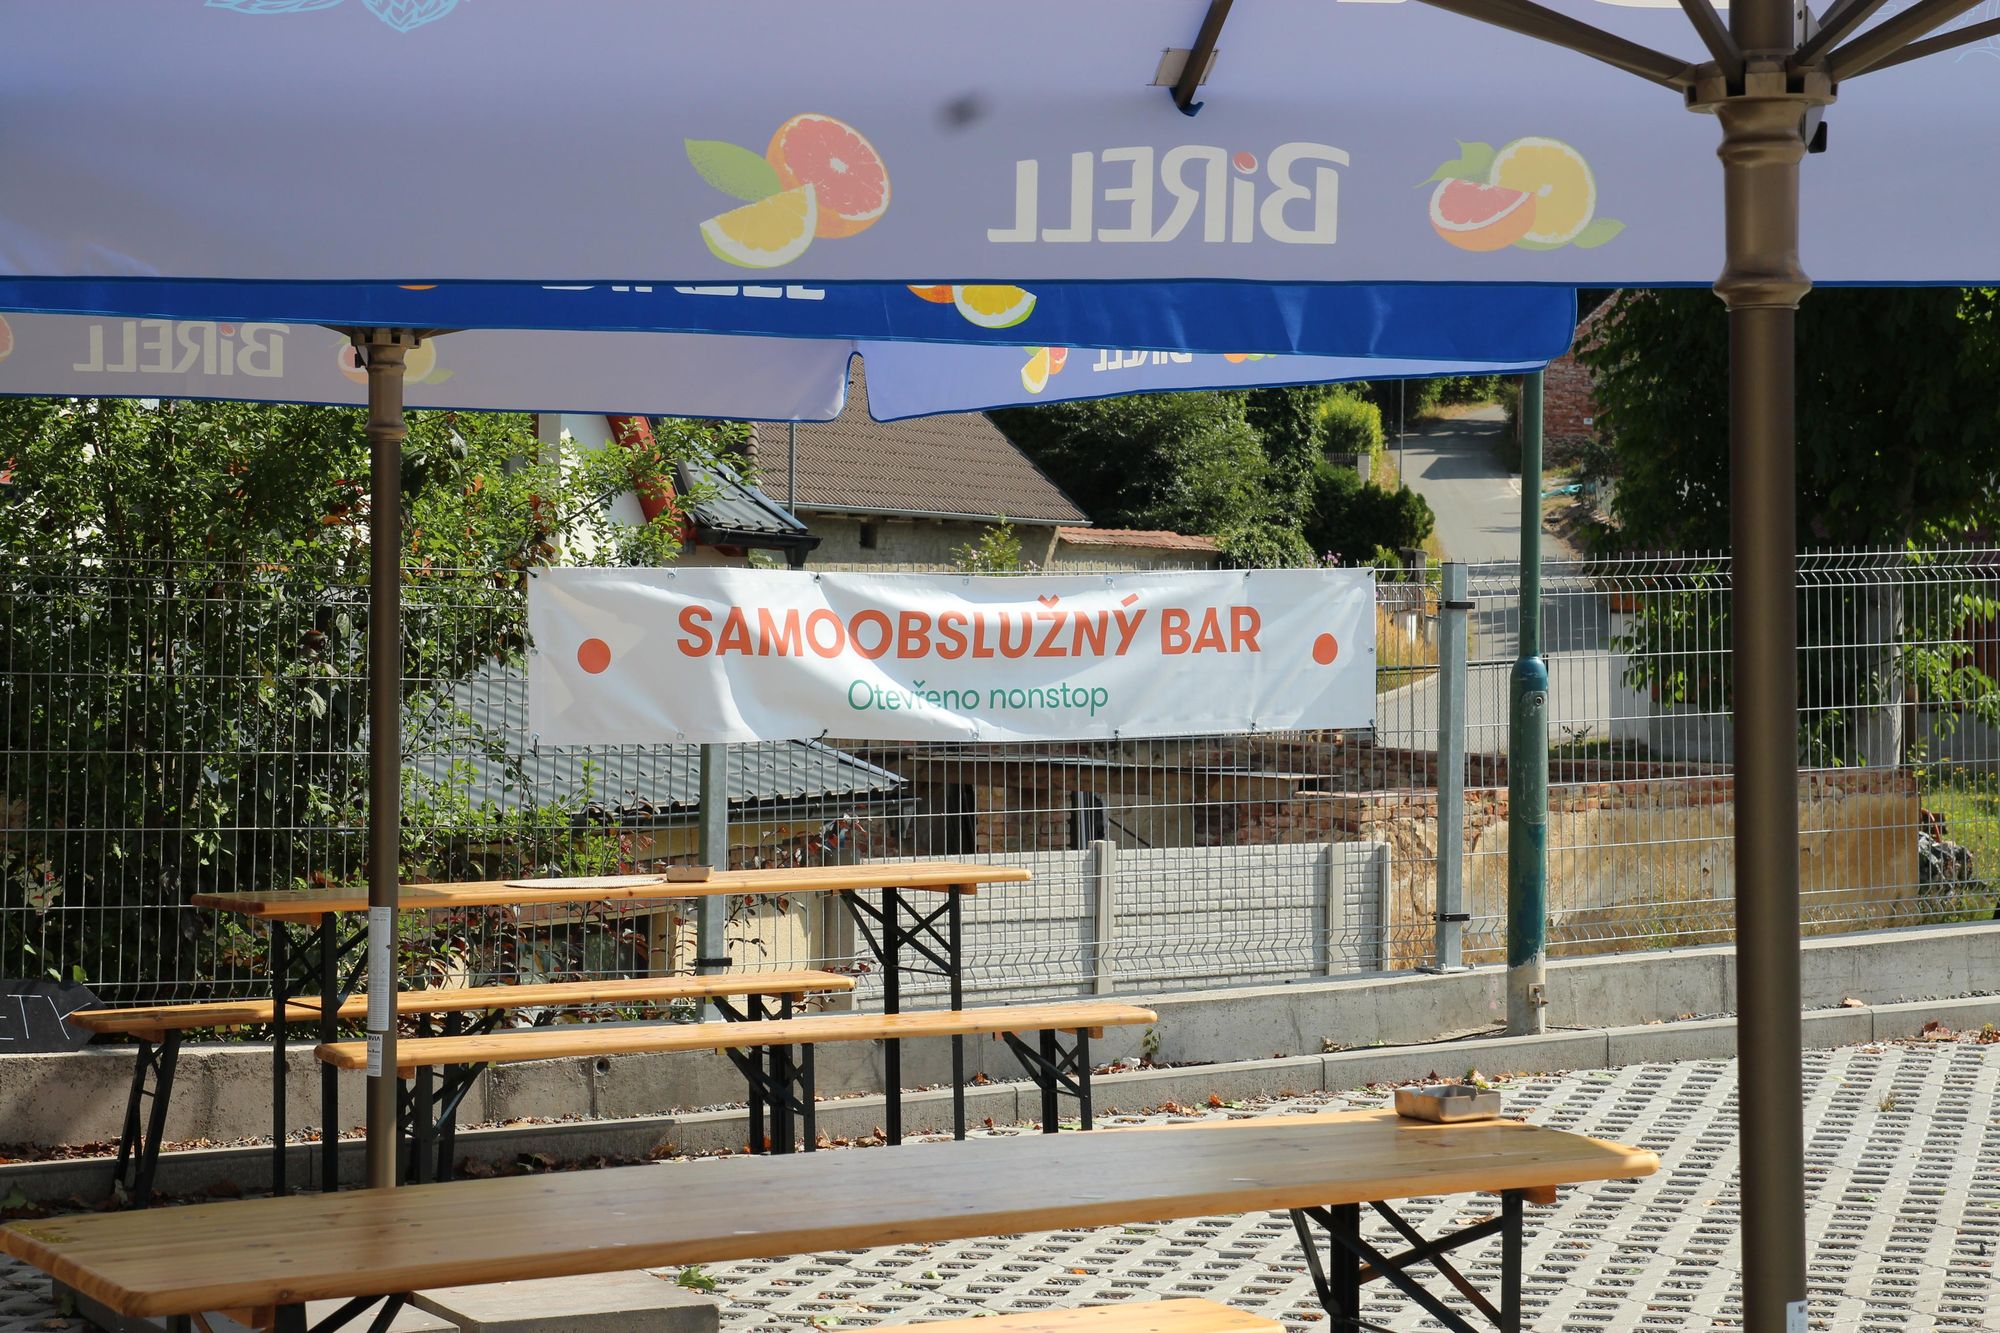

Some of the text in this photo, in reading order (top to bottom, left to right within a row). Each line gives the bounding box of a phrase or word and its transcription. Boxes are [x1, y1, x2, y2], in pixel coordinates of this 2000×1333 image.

[676, 593, 1262, 660] SAMOOBSLUŽNÝ BAR
[847, 680, 1109, 717] Otevřeno nonstop
